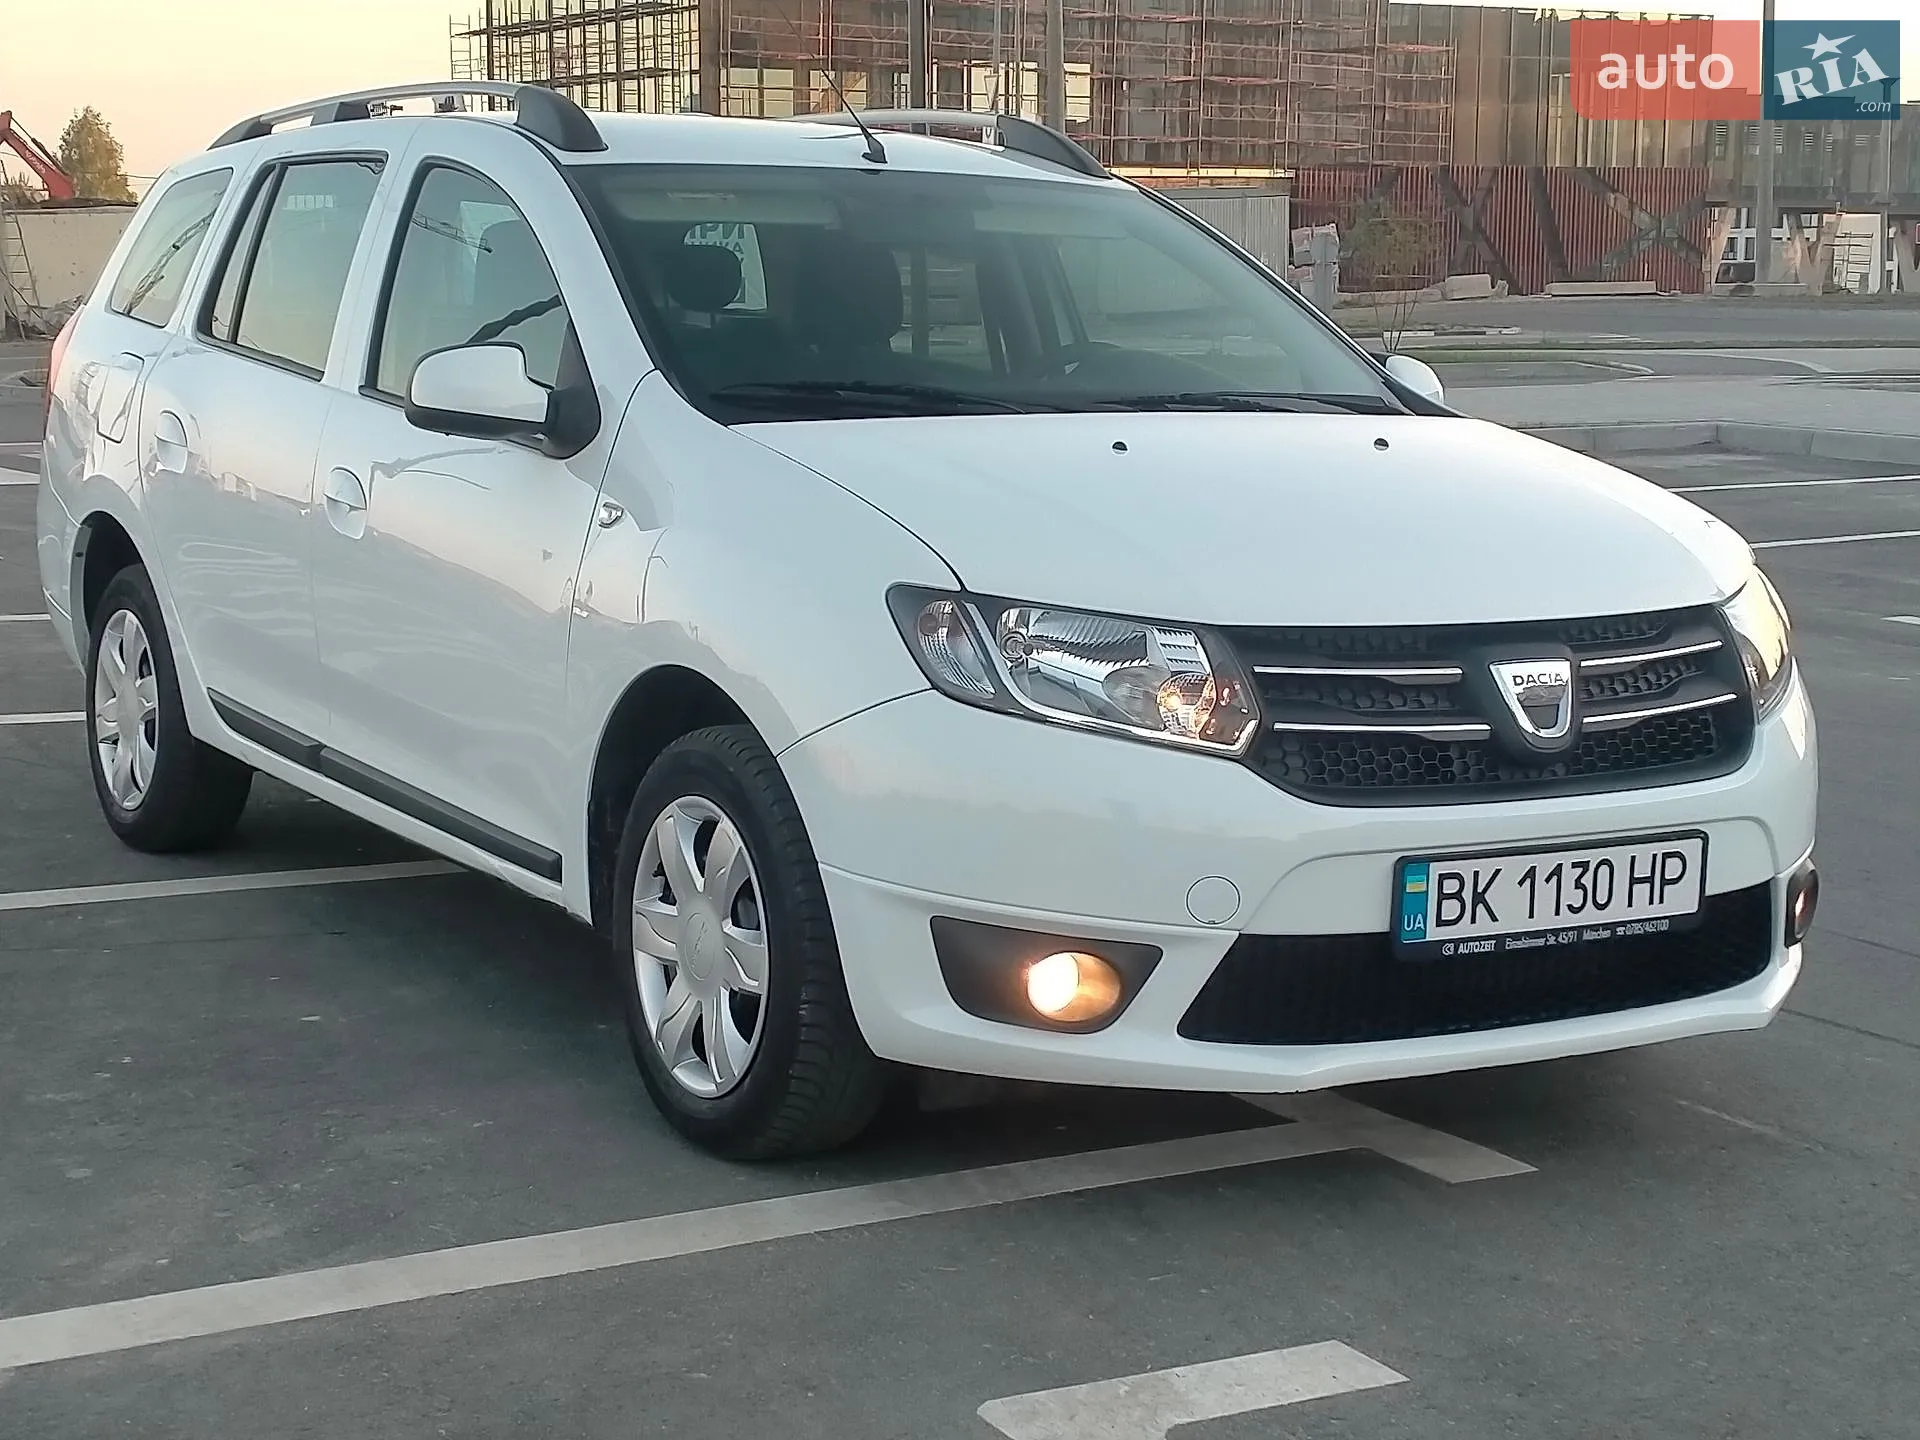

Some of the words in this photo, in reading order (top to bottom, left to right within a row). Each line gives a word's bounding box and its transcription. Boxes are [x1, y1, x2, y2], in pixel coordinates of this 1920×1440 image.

[1511, 673, 1565, 686] DACIA
[1435, 867, 1503, 928] BK
[1517, 858, 1615, 919] 1130
[1627, 850, 1688, 908] HP
[1404, 913, 1425, 931] UA
